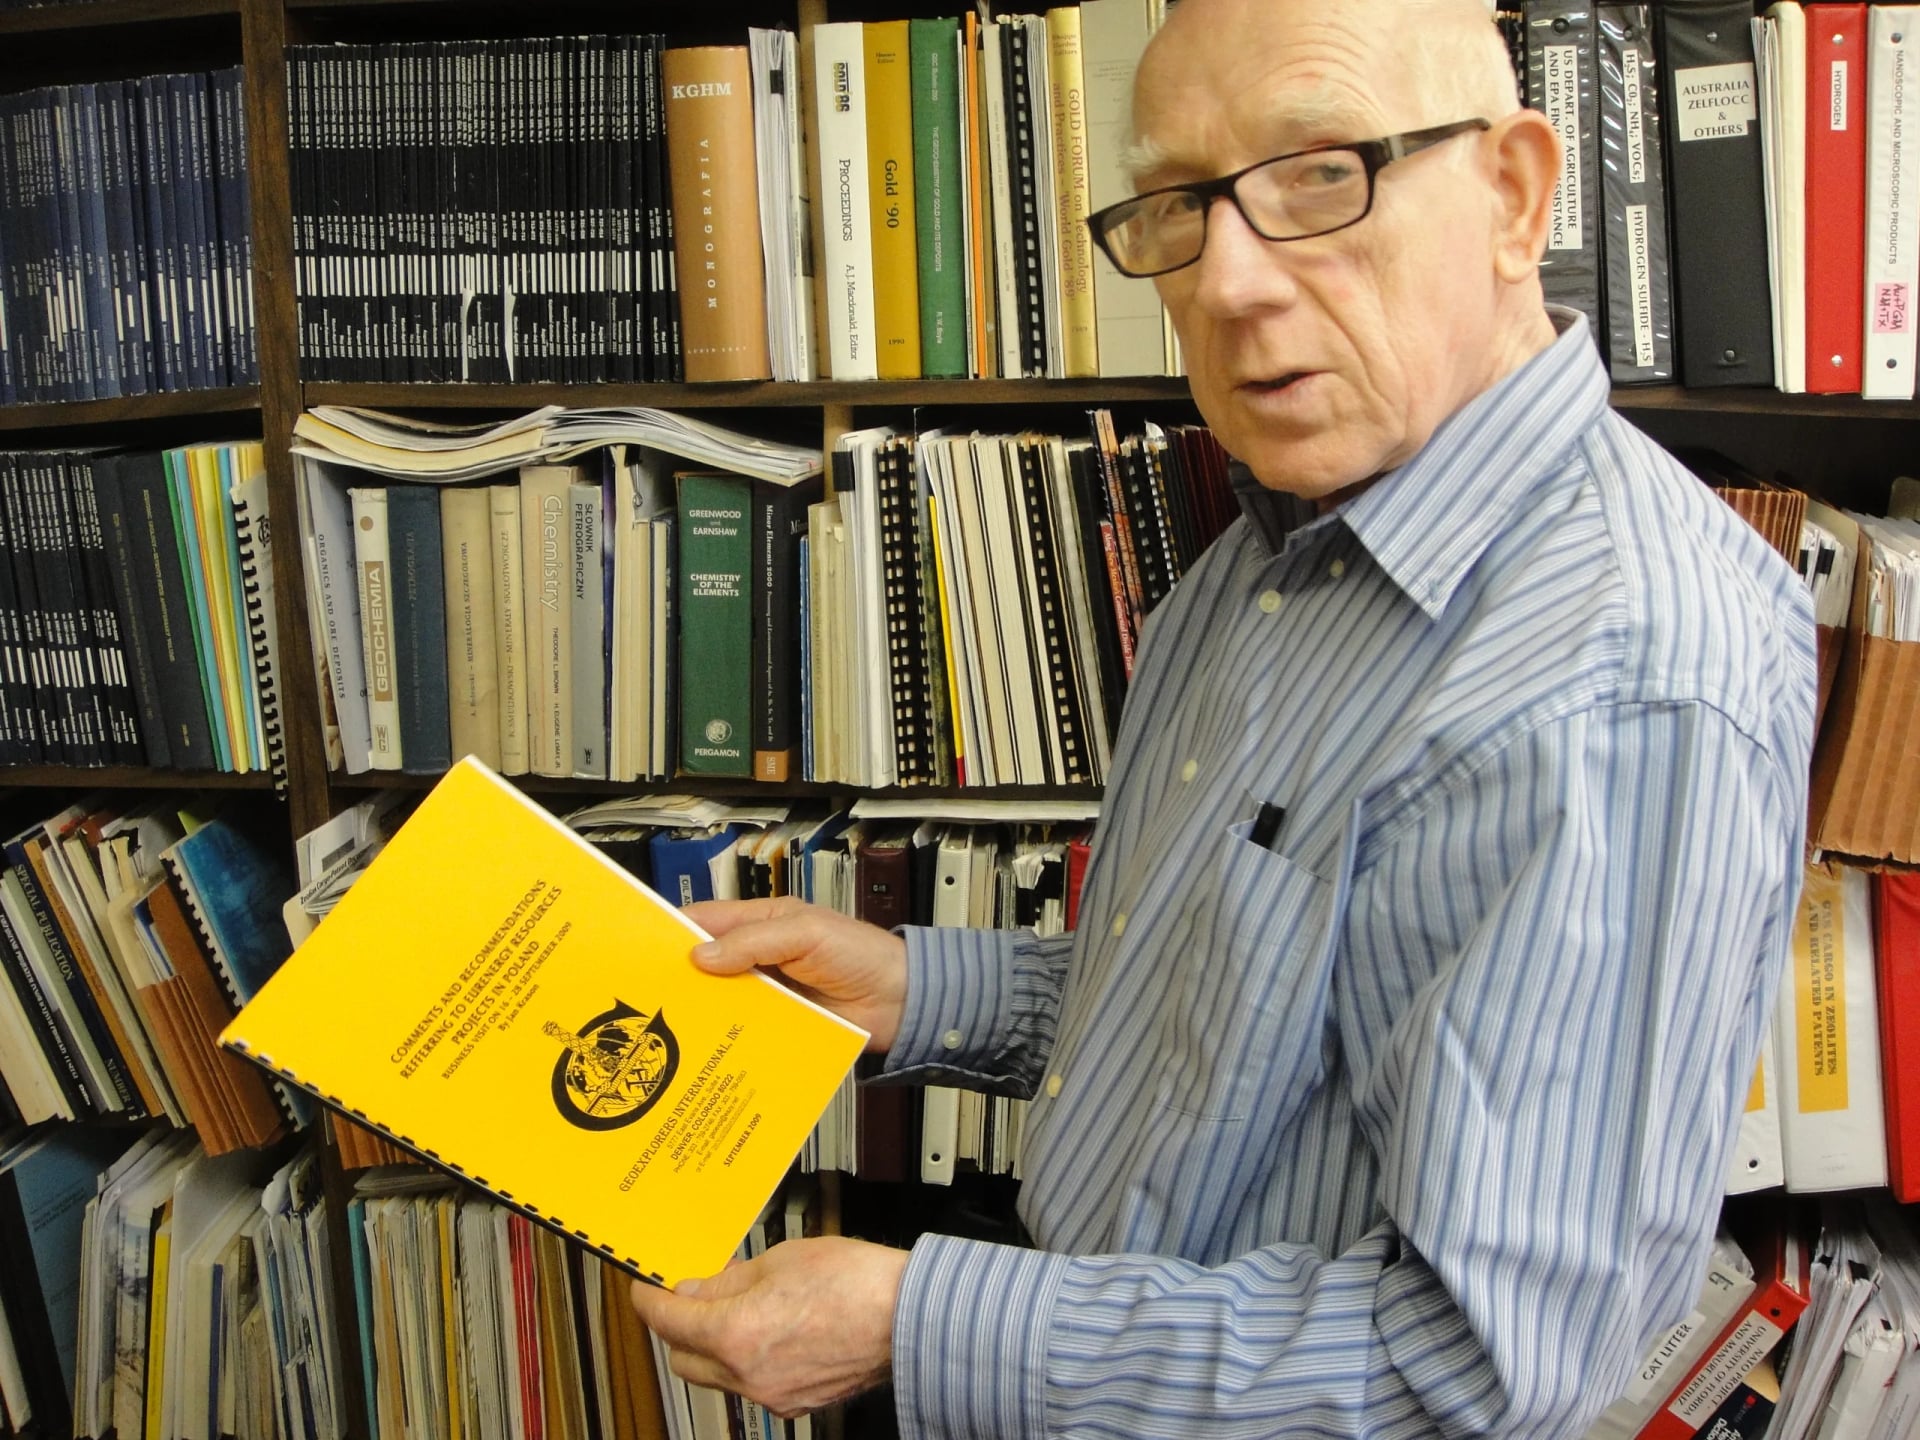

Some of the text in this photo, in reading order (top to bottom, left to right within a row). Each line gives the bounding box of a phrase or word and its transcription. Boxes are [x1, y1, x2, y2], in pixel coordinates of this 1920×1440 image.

[672, 82, 732, 99] KGHM
[1052, 82, 1062, 107] and
[1549, 50, 1559, 103] AND EPA
[1682, 80, 1750, 96] AUSTRALIA
[1688, 94, 1749, 110] ZELFLOCC
[1833, 70, 1841, 126] HYDROGEN
[1068, 89, 1079, 130] GOLD
[1694, 123, 1743, 137] OTHERS
[1717, 111, 1728, 121] &
[1052, 112, 1065, 174] Practices
[1070, 135, 1083, 189] FORUM
[1563, 49, 1576, 229] US DEPART. OF AGRICULTURE
[1888, 49, 1904, 264] NANOSCOPIC AND MICROSCOPIC PRODUCTS
[839, 159, 851, 241] PROCEEDINGS
[884, 159, 897, 196] Gold
[1074, 194, 1082, 211] on
[700, 138, 718, 309] MONOGRAFIA
[1632, 210, 1645, 279] HYDROGEN
[1062, 240, 1072, 269] Gold
[1636, 283, 1648, 330] SULFIDE
[849, 334, 858, 363] Editor
[689, 510, 741, 519] GREENWOOD
[693, 527, 737, 536] EARNSHAW
[539, 495, 563, 611] Chemistry
[575, 503, 583, 599] PETROGRAFICZNY
[690, 574, 741, 582] CHEMISTRY
[693, 588, 740, 597] ELEMENTS
[699, 581, 732, 589] OF THE
[316, 533, 331, 589] ORGANICS
[324, 593, 334, 615] AND
[331, 646, 345, 699] DEPOSITS
[371, 567, 388, 693] GEOCHEMIA
[694, 748, 740, 758] PERGAMON
[766, 757, 776, 775] SME
[14, 863, 42, 909] SPECIAL
[35, 910, 75, 981] PUBLICATION
[389, 877, 547, 1065] COMMENTS AND RECOMMENDATIONS
[399, 885, 562, 1080] REFFERRING TO EURENERGY RESOURCES
[1809, 937, 1821, 1005] RELATED
[1822, 933, 1833, 981] CARGO
[441, 1042, 474, 1080] BUSINESS
[471, 1022, 491, 1044] VISIT
[486, 1009, 501, 1025] ON
[497, 999, 510, 1012] 16
[510, 983, 522, 996] 28
[554, 920, 573, 941] 2009
[450, 938, 541, 1046] PROJECTS IN POLAND
[497, 981, 540, 1033] By Jan Krason
[1824, 986, 1834, 1000] IN
[1811, 1010, 1822, 1076] PATENTS
[1825, 1005, 1836, 1075] ZEOLITES
[618, 1114, 678, 1194] GEOEXPLORERS
[671, 1038, 732, 1118] INTERNATIONAL,
[725, 1020, 744, 1041] INC.
[691, 1091, 721, 1131] COLORADO
[717, 1072, 734, 1093] 80222
[722, 1129, 752, 1167] SEPTEMBER
[747, 1112, 762, 1130] 2009
[1640, 1321, 1692, 1382] CAT LITTER
[1732, 1319, 1753, 1340] AND
[1683, 1324, 1766, 1417] UNIVERSITY OF FLORIDA
[1703, 1338, 1736, 1374] MANURE
[1738, 1346, 1763, 1373] NATO
[1709, 1370, 1743, 1406] PROJECT
